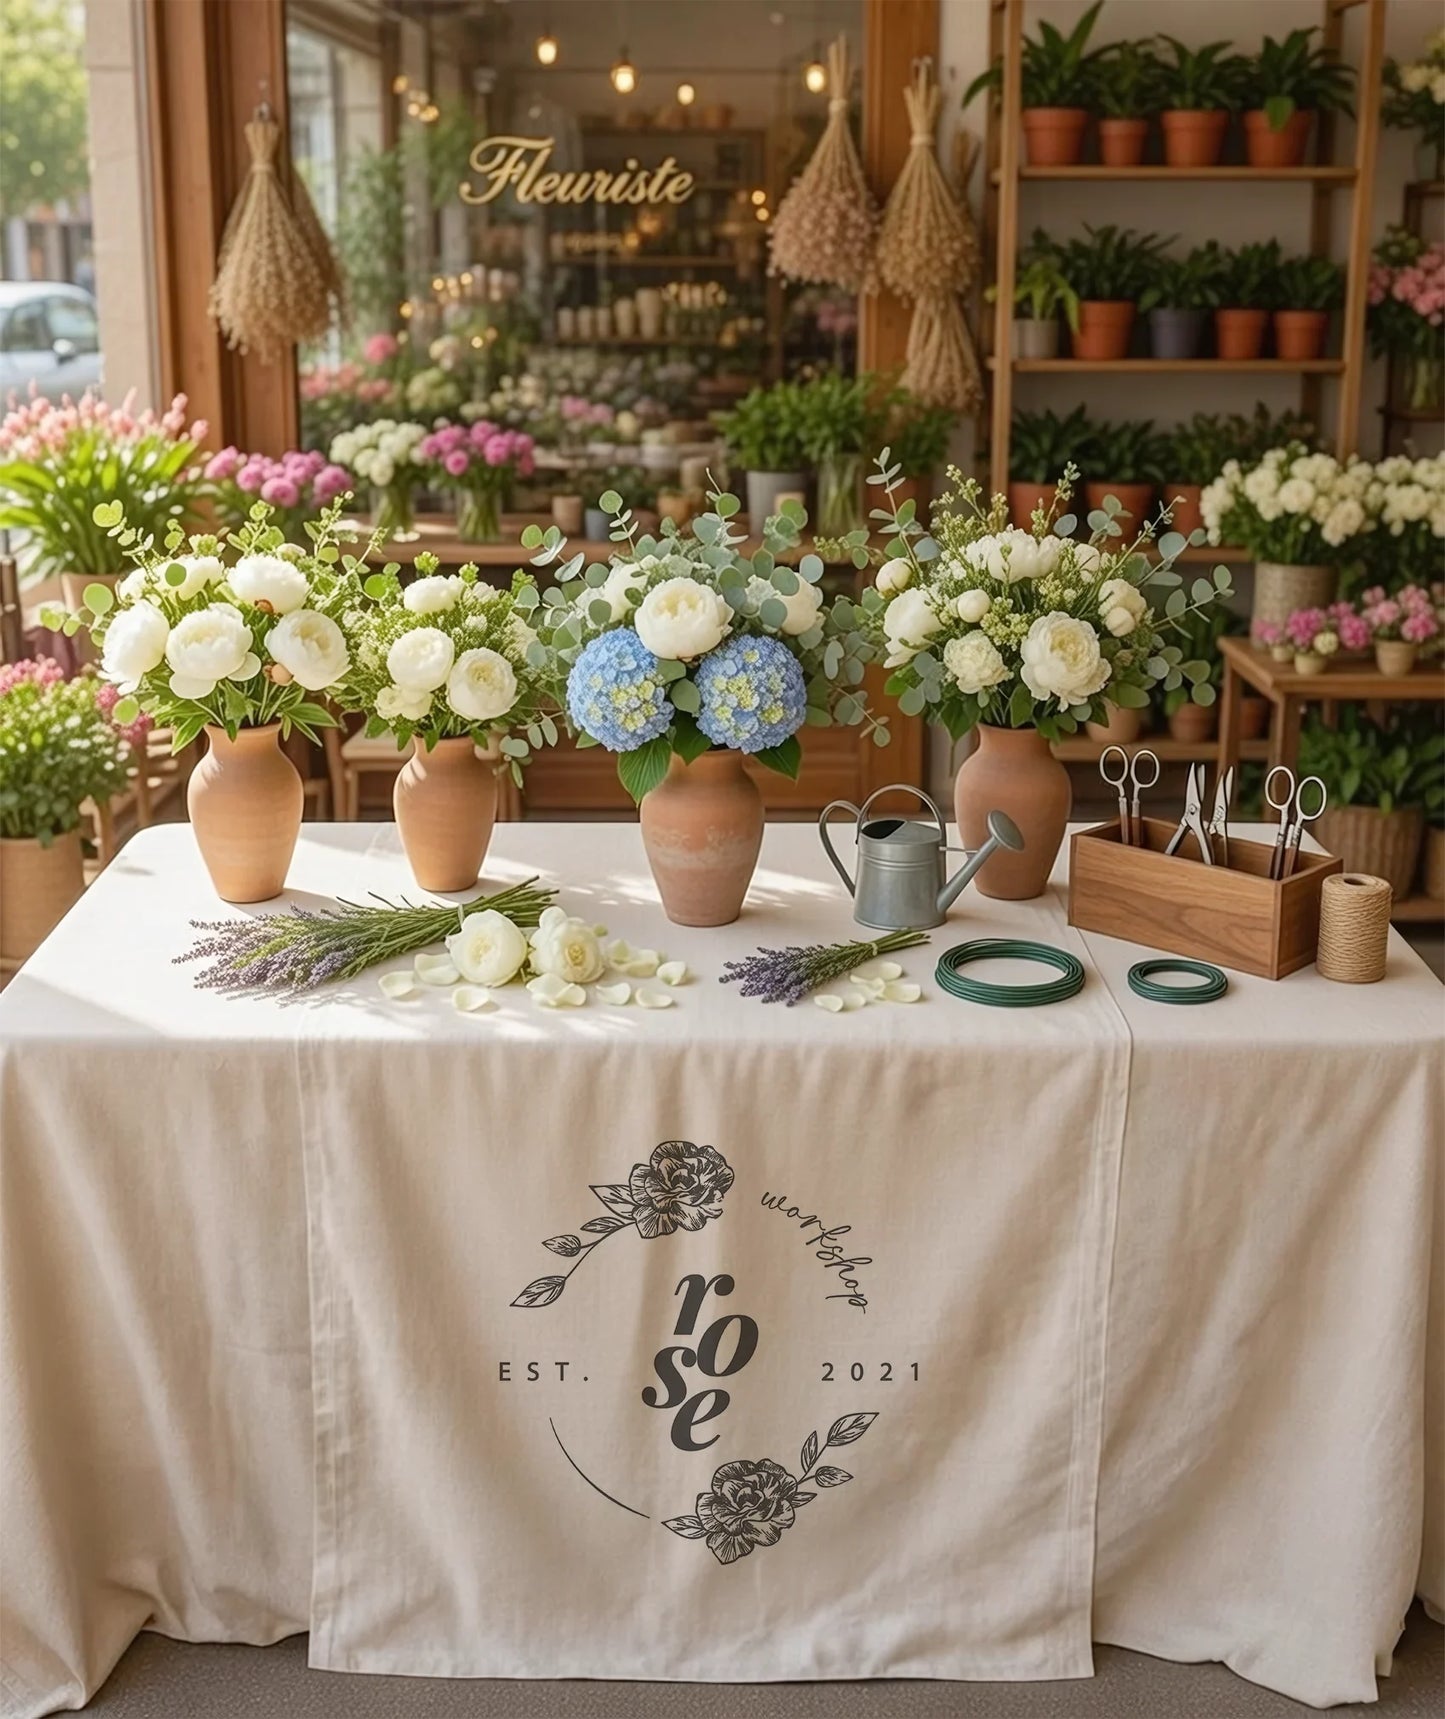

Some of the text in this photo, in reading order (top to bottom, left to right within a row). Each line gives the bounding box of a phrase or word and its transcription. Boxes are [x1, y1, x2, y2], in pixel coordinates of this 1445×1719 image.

[459, 136, 694, 204] Fleuriste
[760, 1191, 873, 1315] workshop
[499, 1361, 920, 1382] EST. 2021
